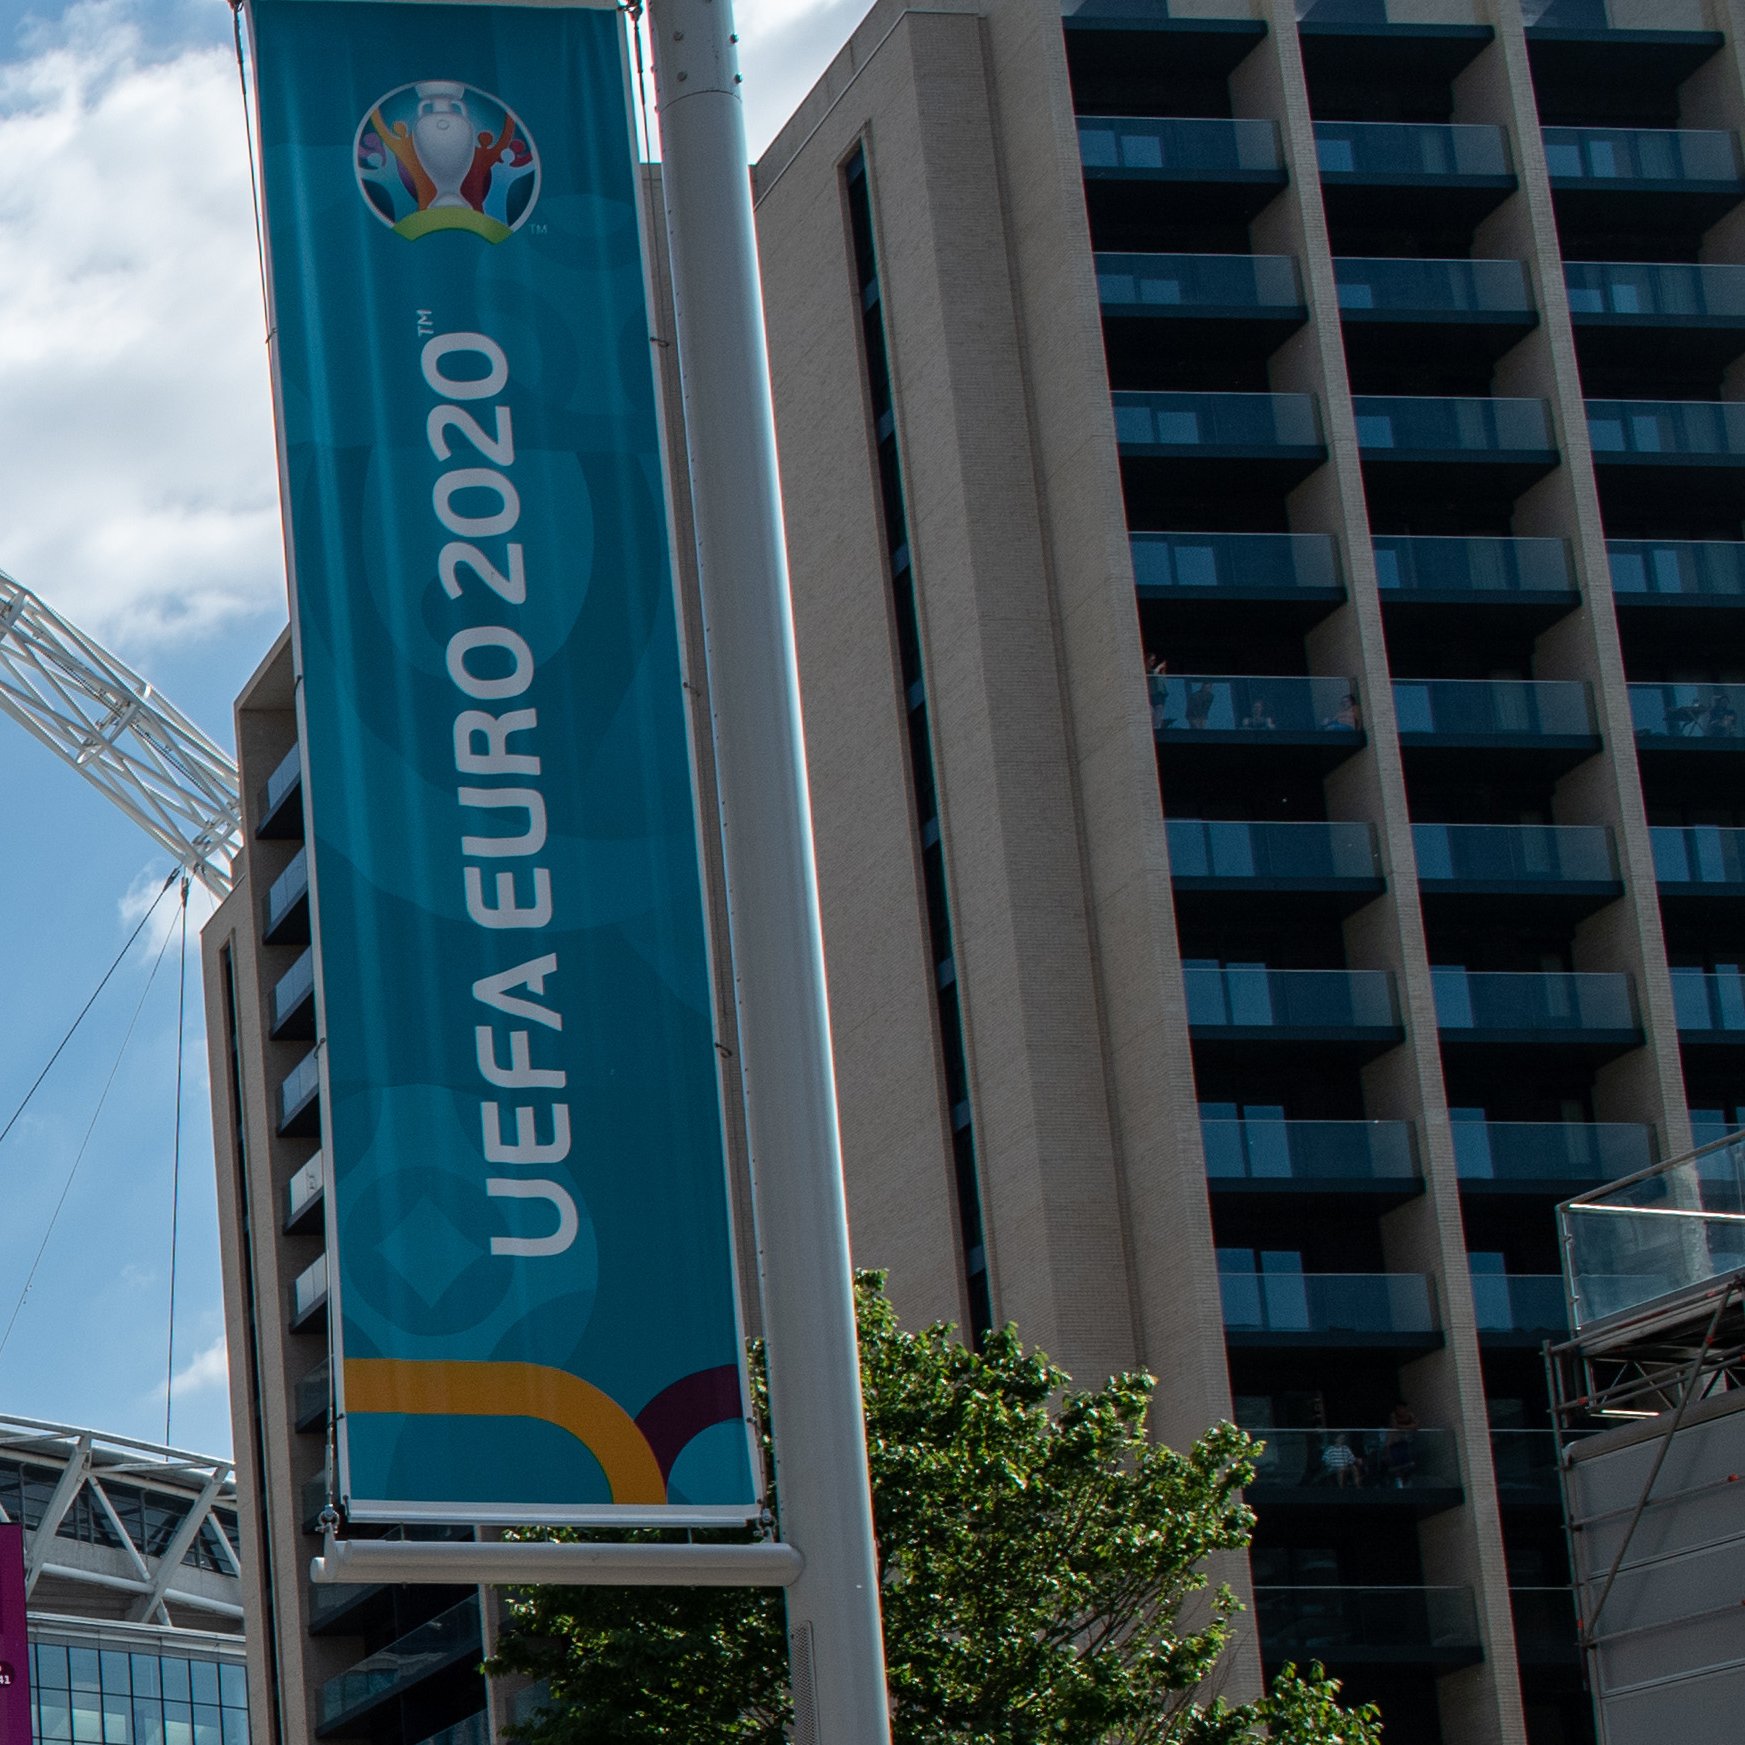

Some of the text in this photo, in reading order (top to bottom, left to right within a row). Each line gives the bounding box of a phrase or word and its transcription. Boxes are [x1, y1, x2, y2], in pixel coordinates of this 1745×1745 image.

[420, 331, 526, 603] 2020
[447, 626, 553, 928] EURO
[473, 953, 579, 1256] UEFA
